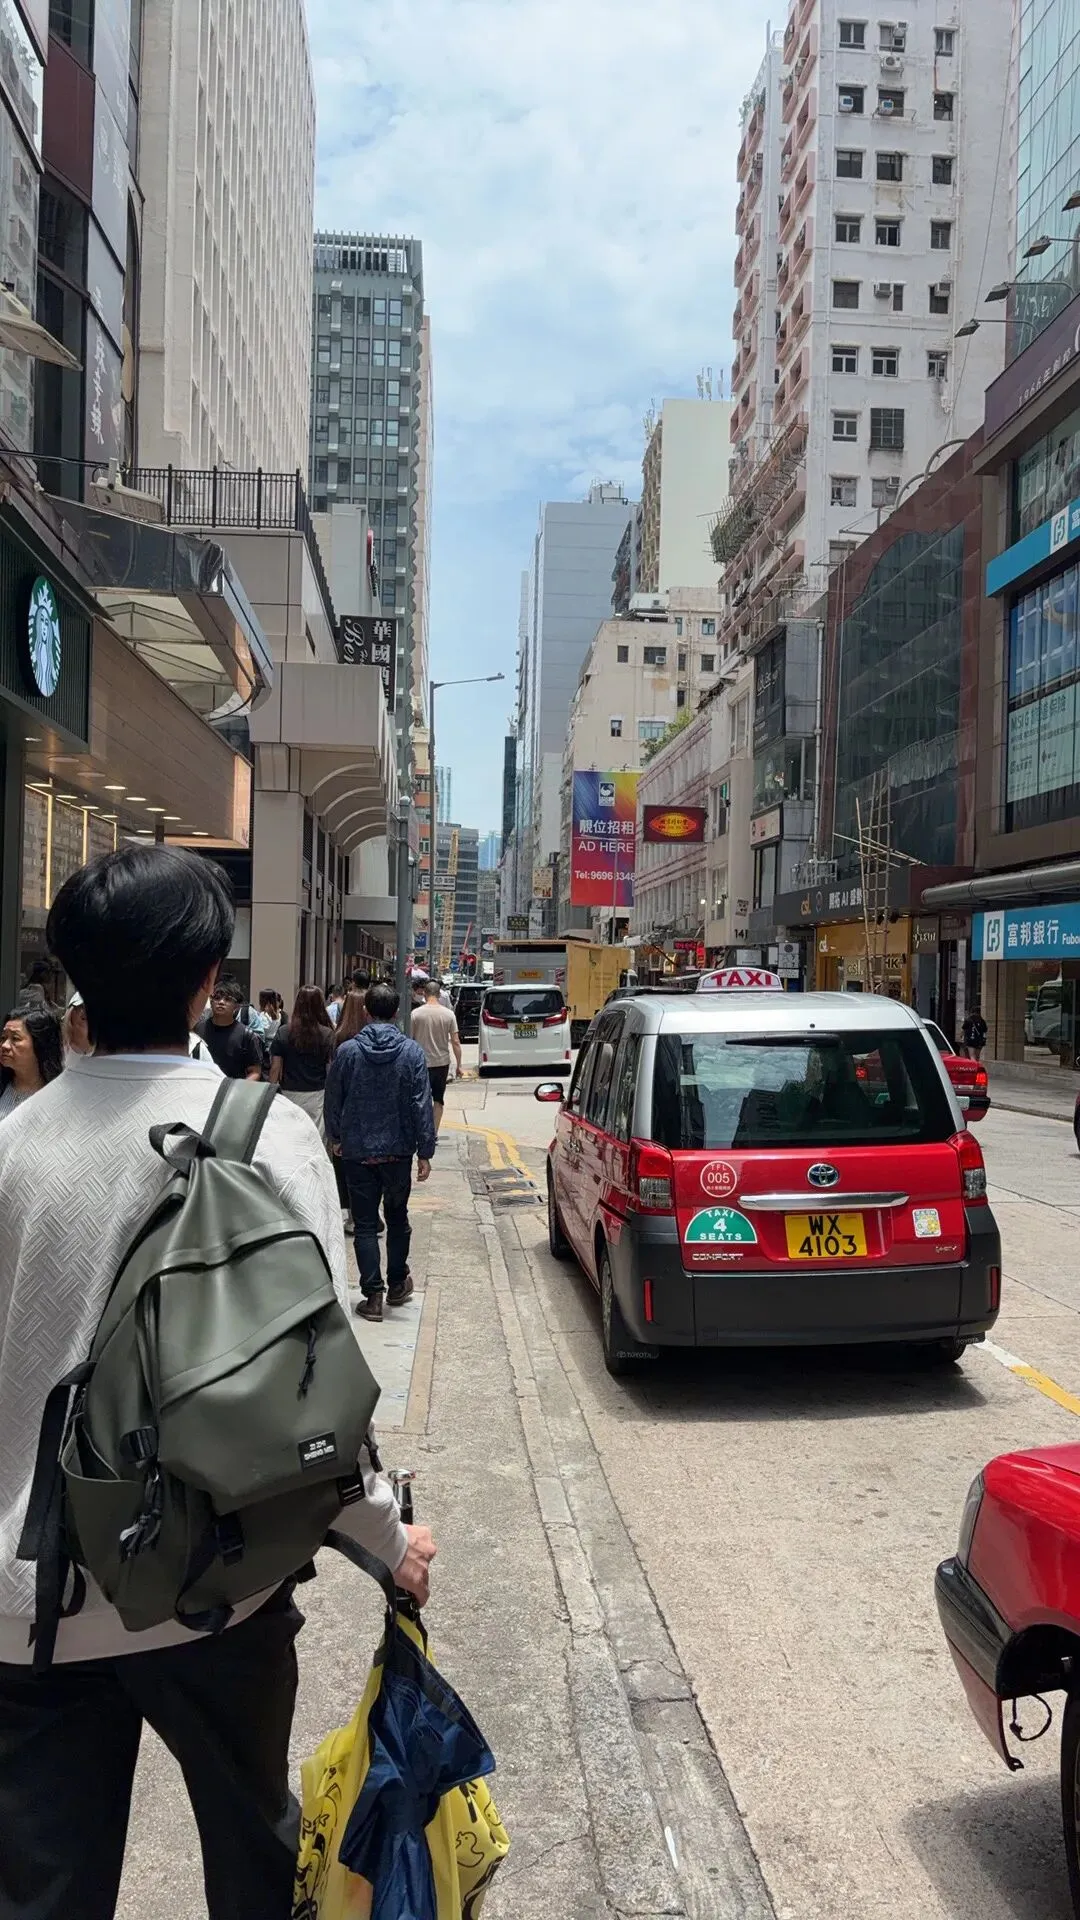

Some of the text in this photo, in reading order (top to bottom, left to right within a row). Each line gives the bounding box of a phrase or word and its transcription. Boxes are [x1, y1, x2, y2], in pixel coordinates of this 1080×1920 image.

[579, 819, 635, 835] 靚位招租
[578, 841, 634, 853] AD HERE
[1007, 919, 1060, 947] 富邦銀行
[711, 969, 772, 987] TAXI
[710, 1163, 727, 1171] TFL
[707, 1172, 730, 1184] 005
[706, 1209, 734, 1219] TAXI
[713, 1218, 727, 1232] 4
[808, 1215, 842, 1236] WX
[699, 1232, 742, 1241] SEATS
[798, 1234, 857, 1258] 4103
[692, 1252, 744, 1261] COMFORT
